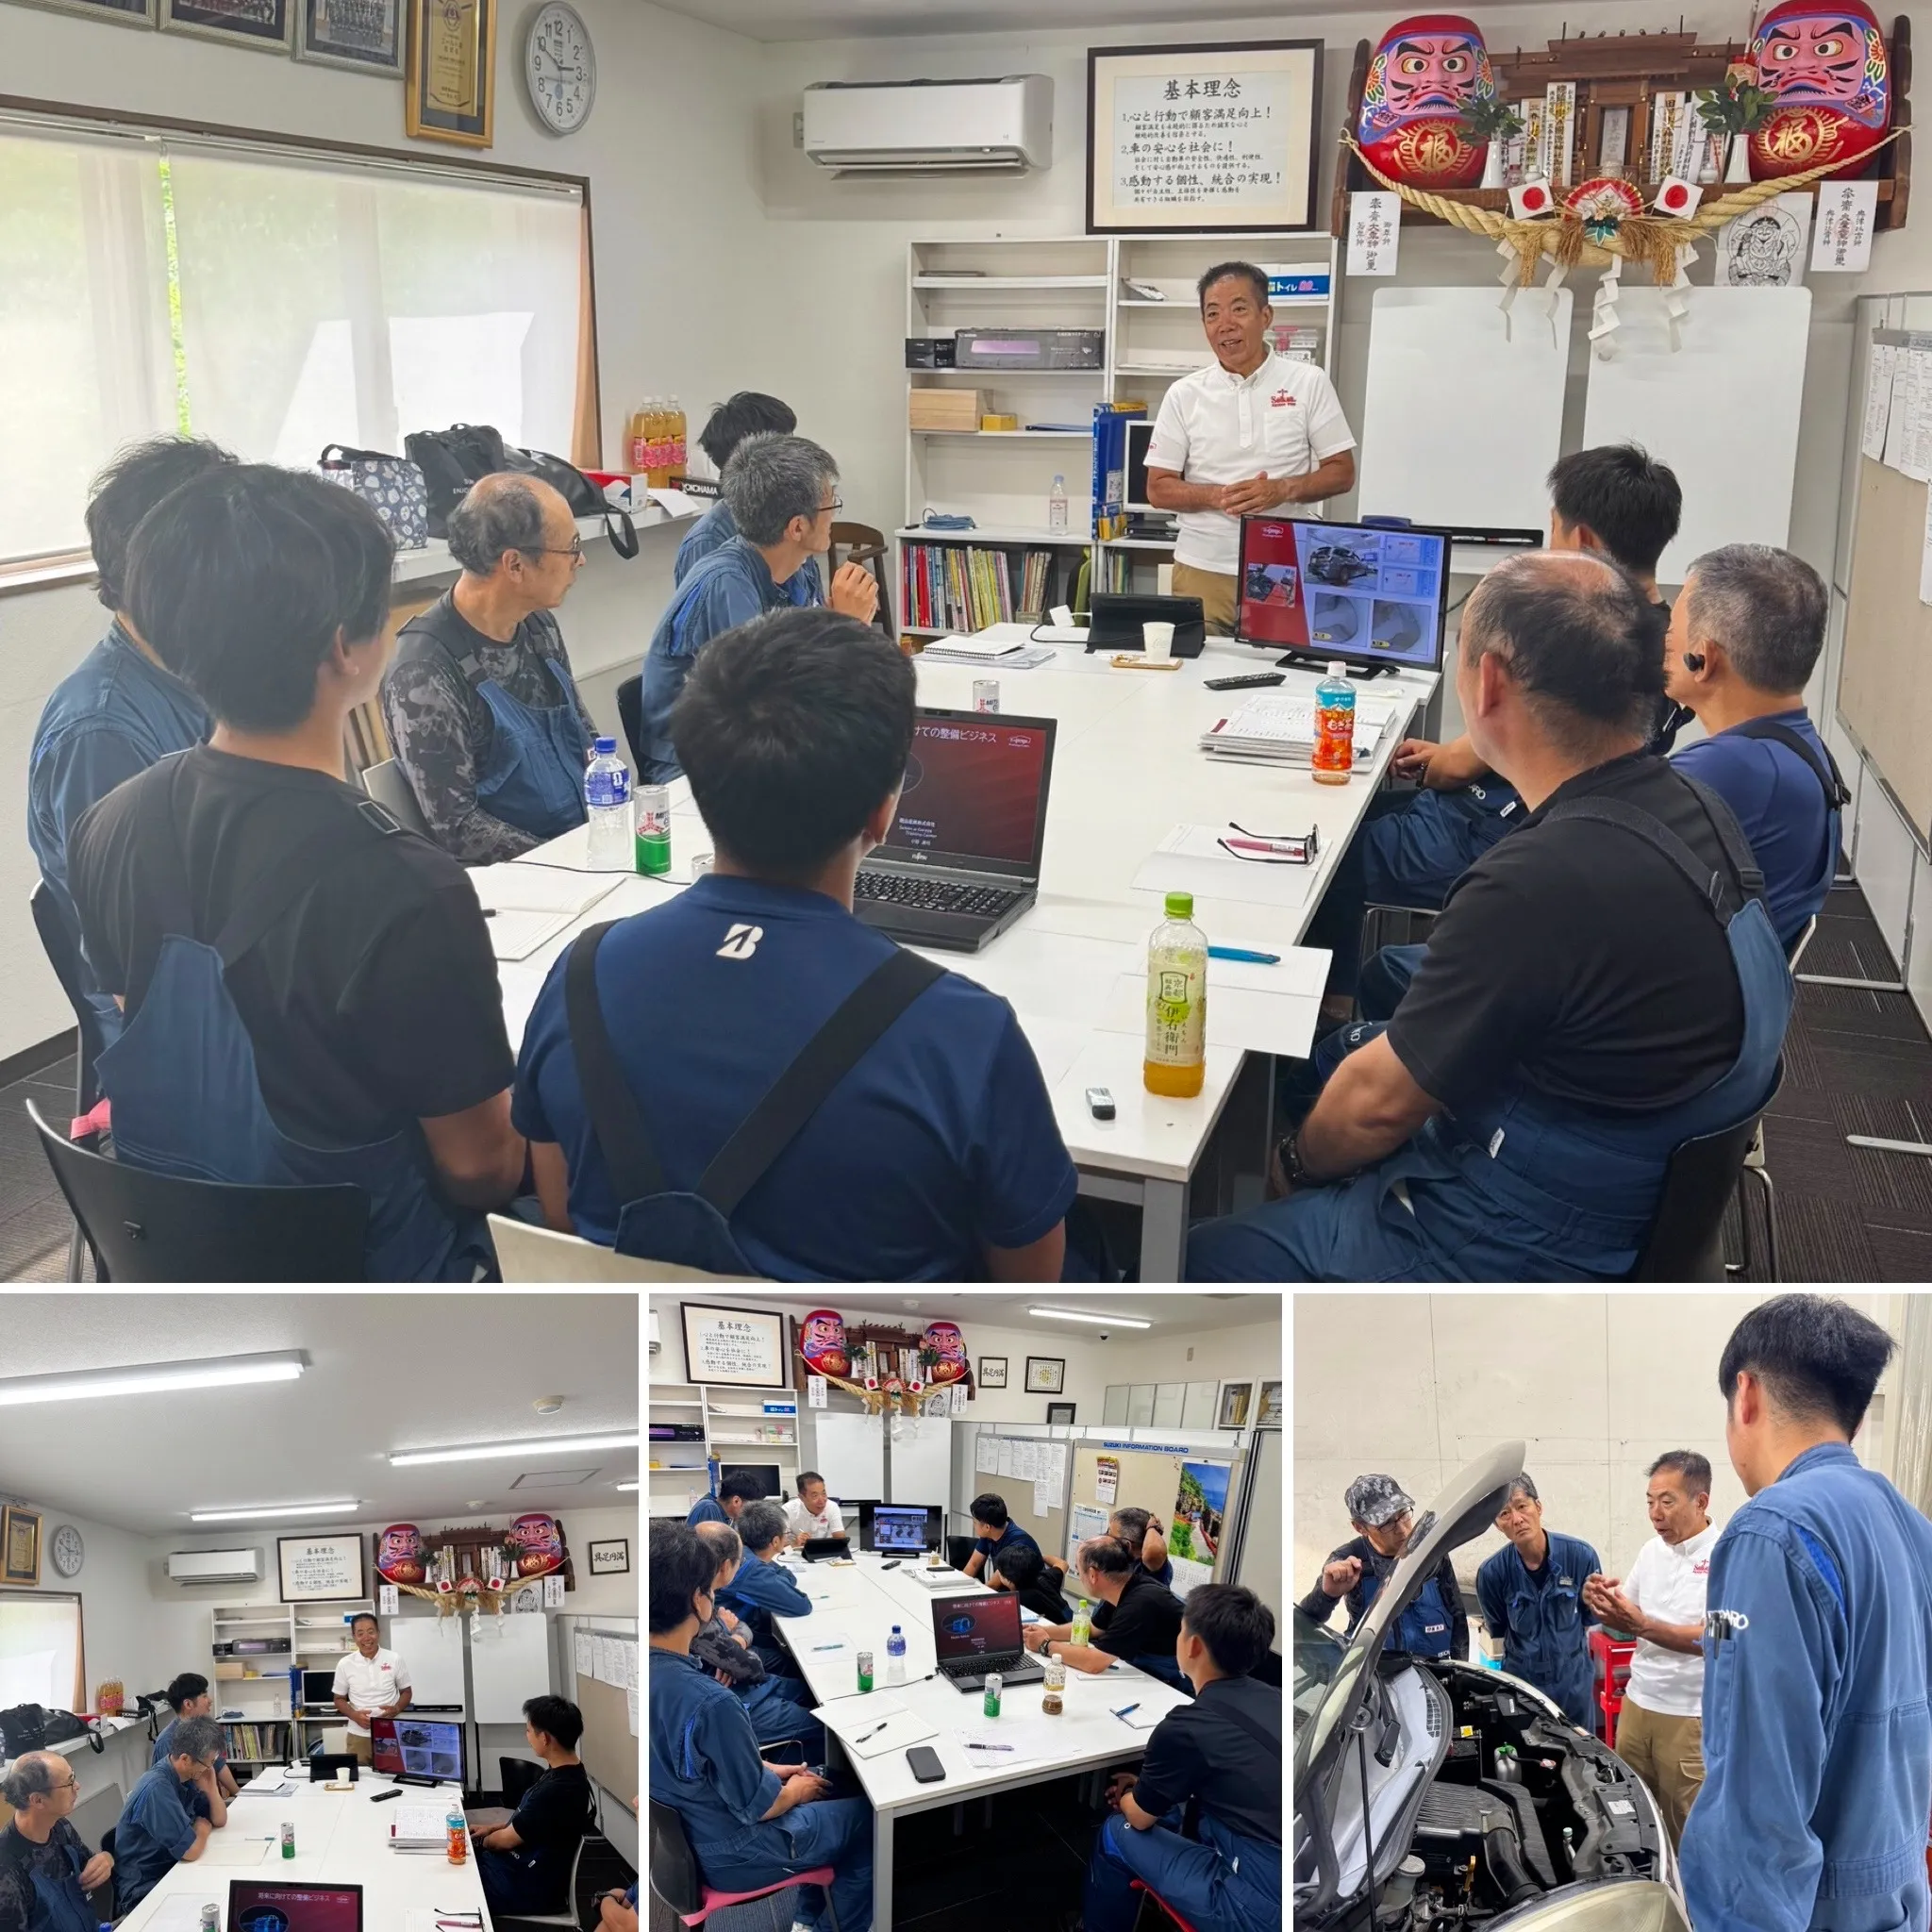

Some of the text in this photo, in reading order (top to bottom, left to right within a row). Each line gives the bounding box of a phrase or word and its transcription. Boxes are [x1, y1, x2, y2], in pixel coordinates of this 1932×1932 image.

[545, 23, 552, 38] 11
[554, 20, 563, 36] 12
[538, 36, 546, 51] 10
[567, 29, 571, 43] 1
[574, 45, 580, 60] 2
[534, 56, 541, 71] 9
[575, 66, 583, 81] 3
[538, 77, 545, 92] 8
[1163, 77, 1241, 100] 基本理念
[546, 93, 553, 108] 7
[574, 86, 580, 100] 4
[556, 101, 563, 116] 6
[567, 98, 573, 113] 5
[1123, 1443, 1163, 1452] INFORMATION
